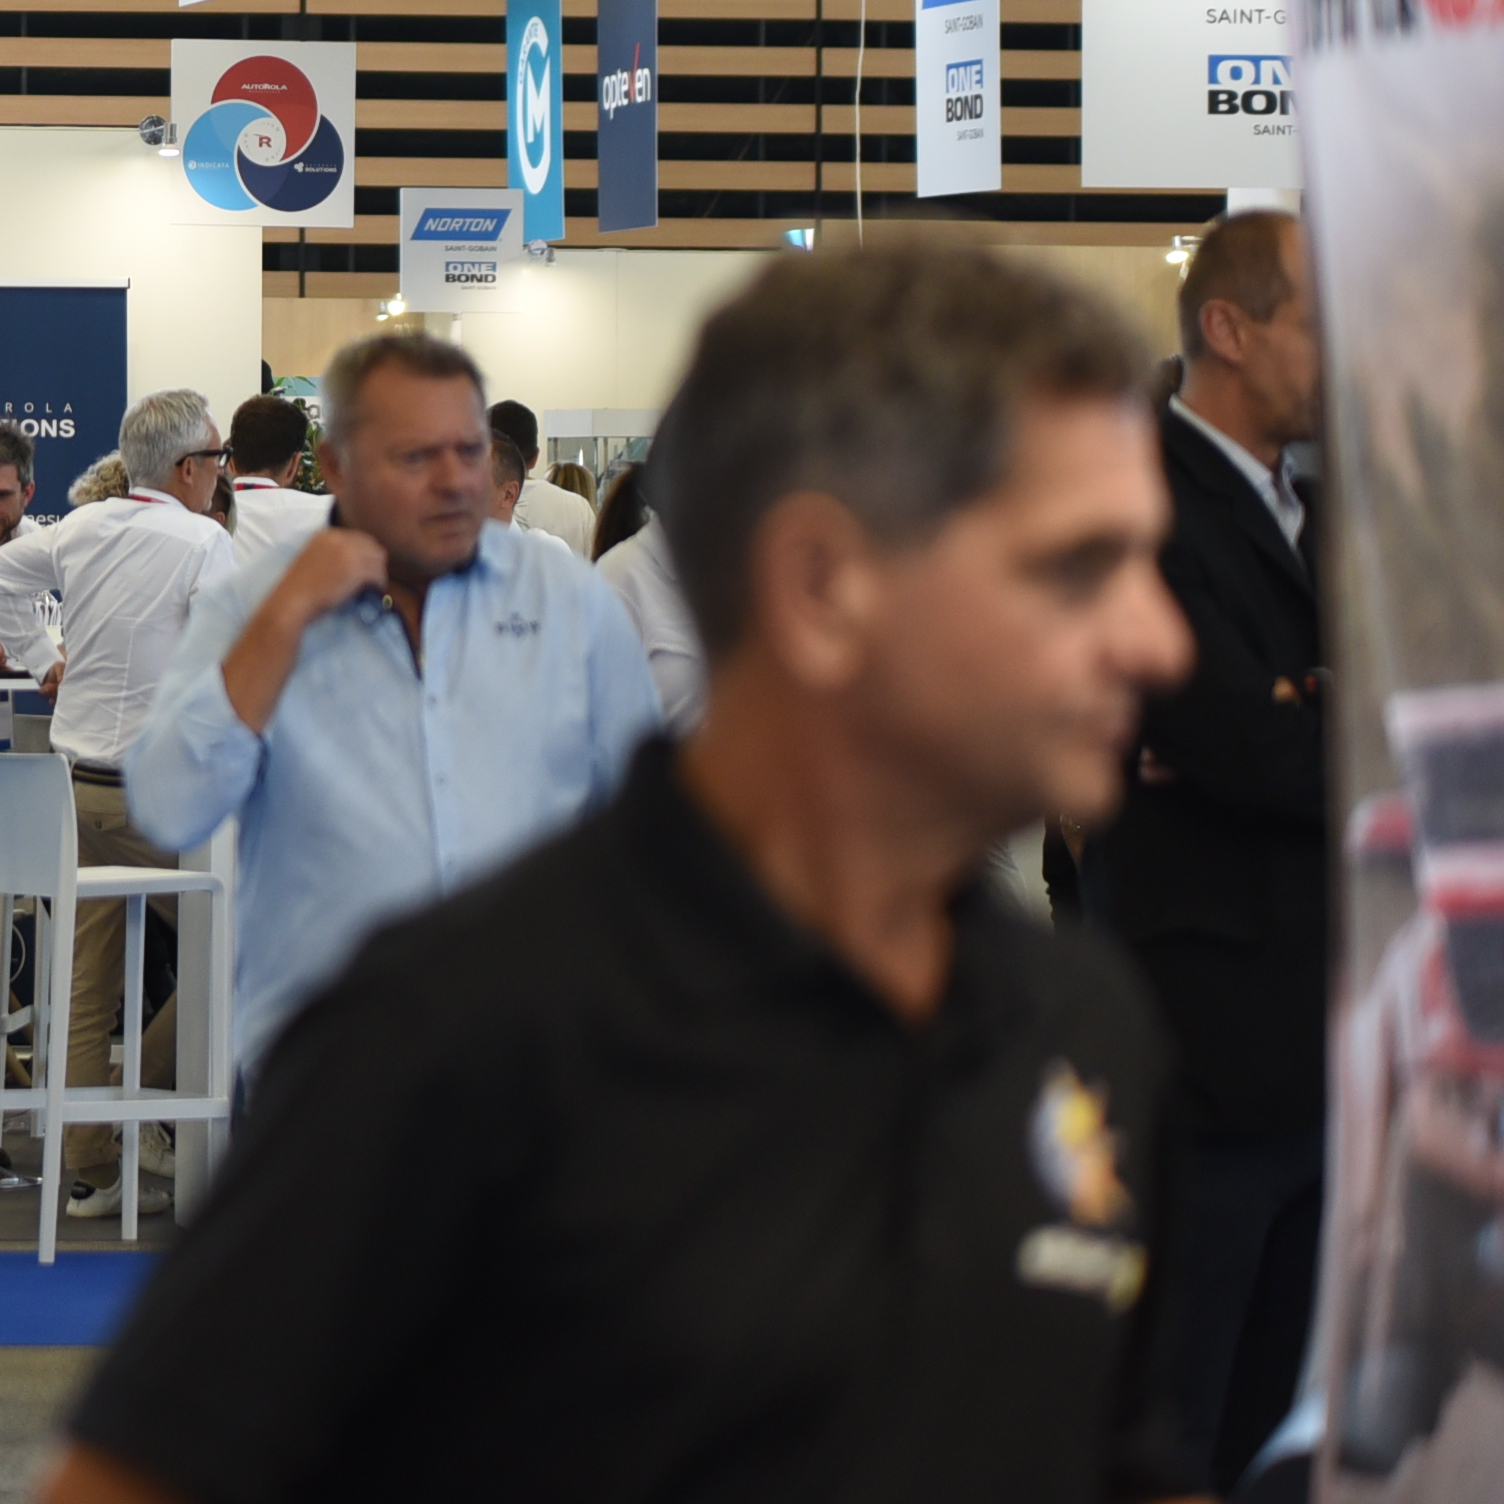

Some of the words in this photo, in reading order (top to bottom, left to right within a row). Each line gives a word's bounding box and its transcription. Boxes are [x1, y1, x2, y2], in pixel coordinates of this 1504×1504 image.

[944, 14, 984, 34] SAINT-GOBAIN
[1206, 8, 1287, 25] SAINT-G
[948, 63, 983, 93] ONE
[1215, 59, 1293, 84] ON
[241, 83, 288, 91] AUTOROLA
[945, 94, 983, 123] BOND
[1207, 90, 1298, 116] BO
[1252, 124, 1297, 137] SAINT-
[423, 218, 498, 232] NORTON
[447, 262, 497, 272] ONE
[445, 273, 497, 284] BOND
